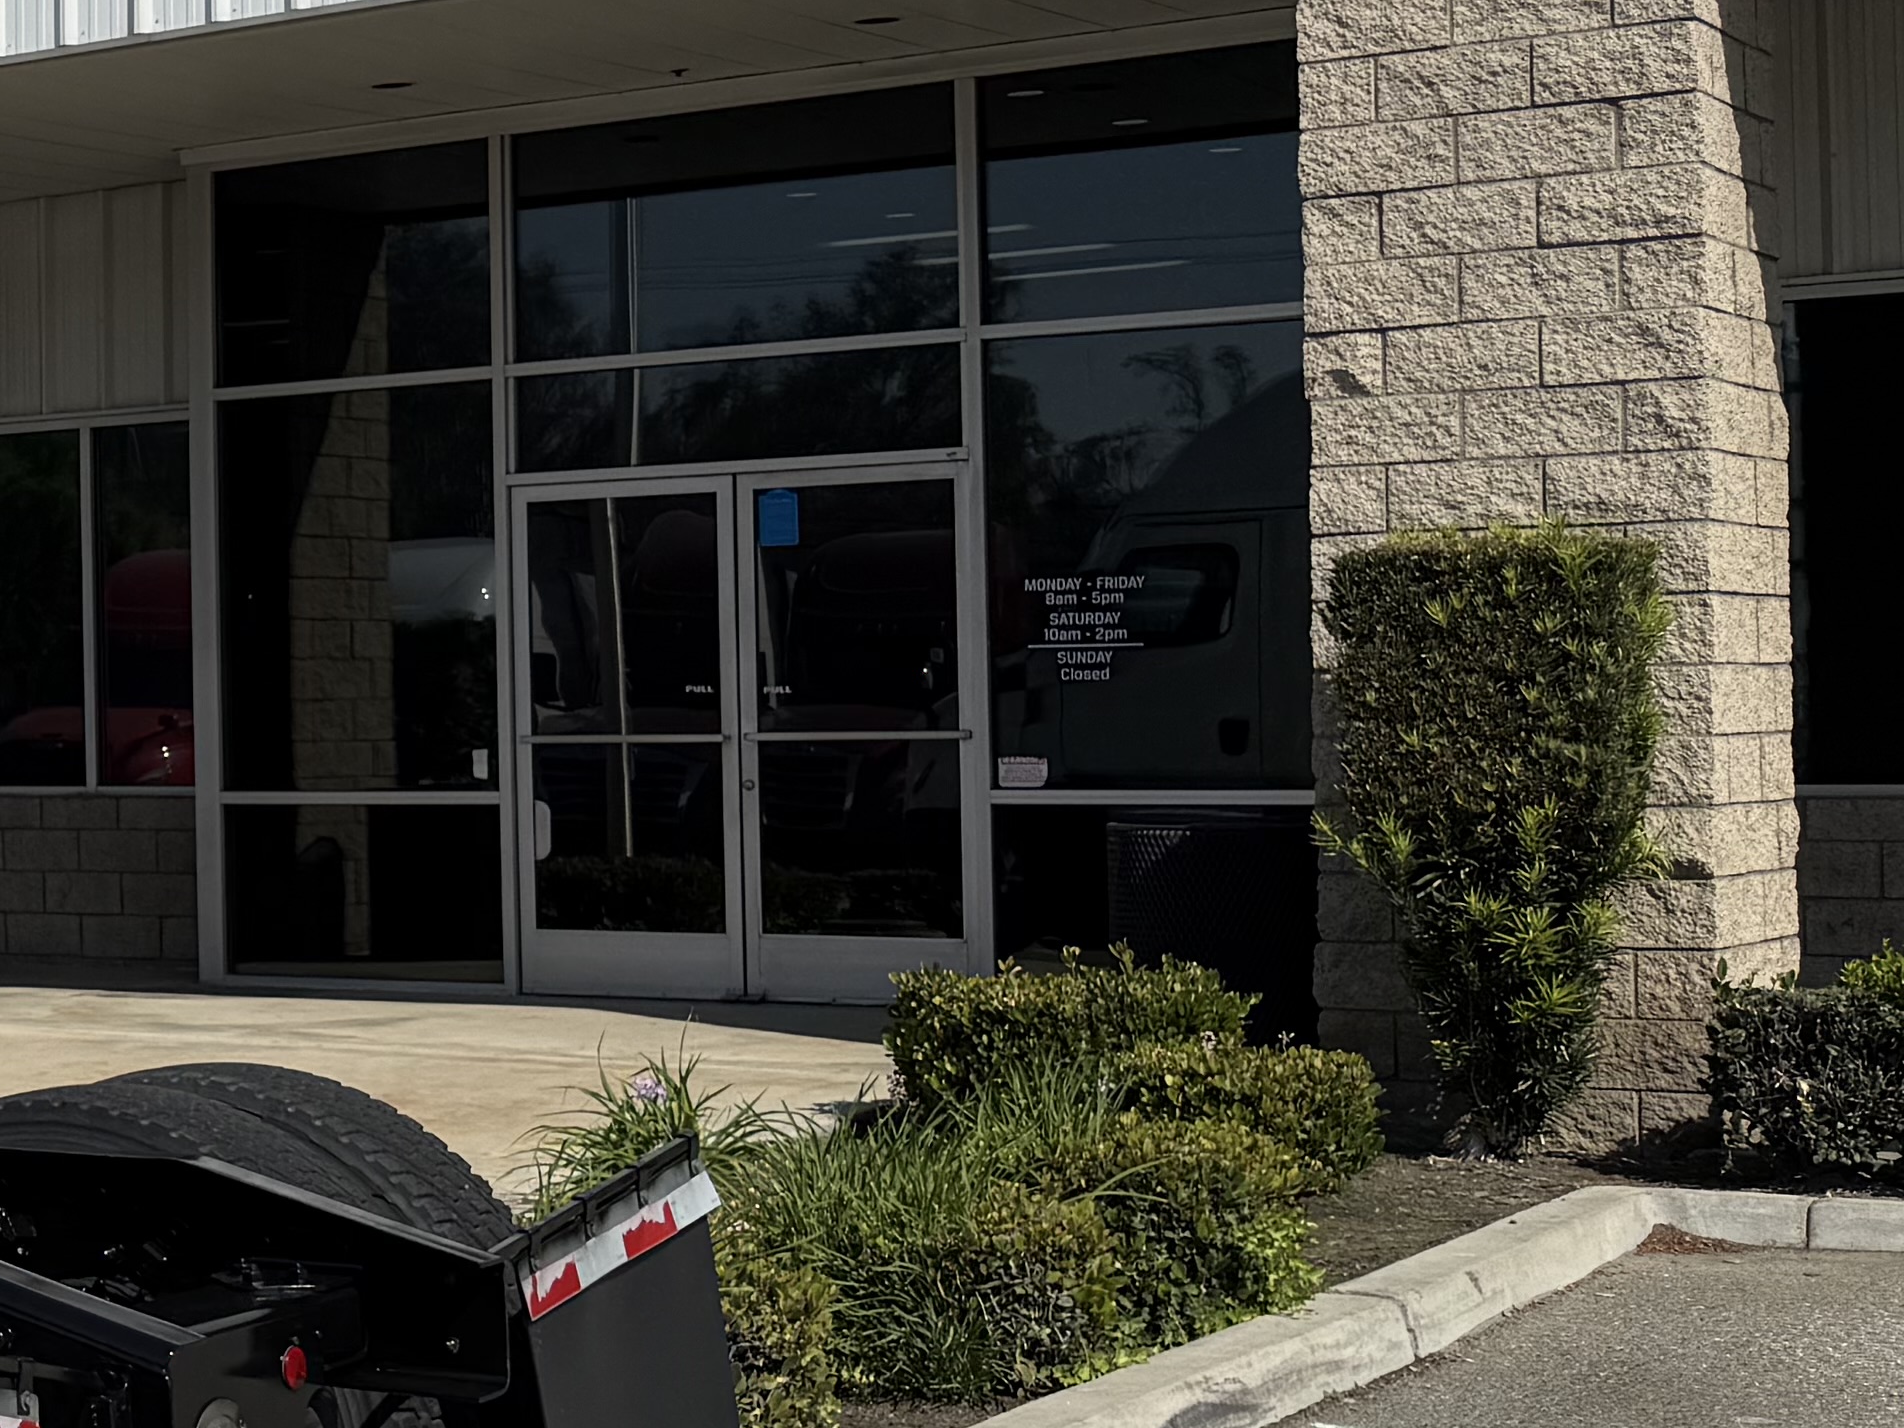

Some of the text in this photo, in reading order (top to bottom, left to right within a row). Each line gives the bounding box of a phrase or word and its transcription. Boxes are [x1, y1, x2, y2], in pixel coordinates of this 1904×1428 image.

[1024, 577, 1082, 592] MONDAY
[1096, 575, 1145, 590] FRIDAY
[1045, 592, 1078, 605] 8am
[1091, 591, 1125, 606] 5pm
[1049, 611, 1121, 626] SATURDAY
[1044, 628, 1081, 641] 10am
[1095, 628, 1128, 642] 2pm
[1057, 651, 1113, 665] SUNDAY
[1060, 666, 1110, 681] Closed
[685, 684, 714, 694] PULL
[763, 685, 793, 694] PULL
